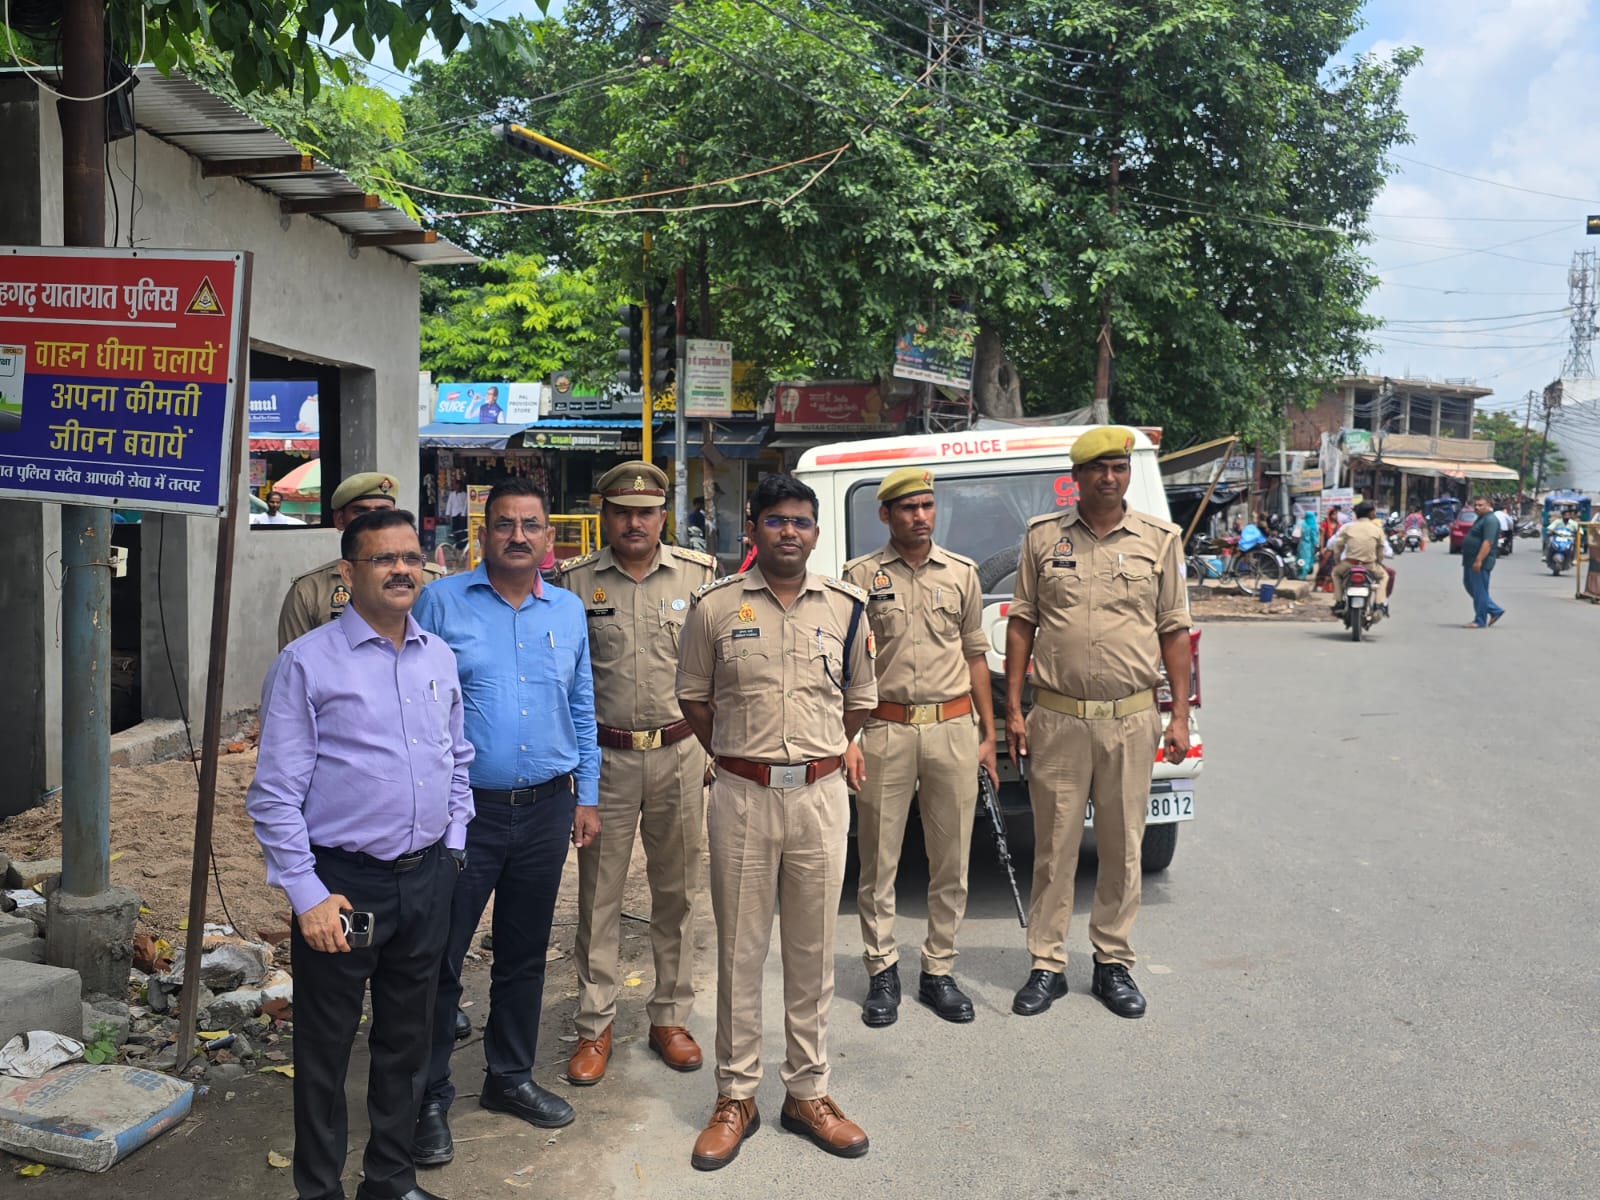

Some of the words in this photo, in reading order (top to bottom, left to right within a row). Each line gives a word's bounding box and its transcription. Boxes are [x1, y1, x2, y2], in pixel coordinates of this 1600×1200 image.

[41, 283, 118, 309] यातायात
[122, 277, 179, 319] पुलिस
[34, 340, 90, 369] वाहन
[96, 337, 147, 371] धीमा
[151, 340, 224, 375] चलायें
[50, 383, 119, 412] अपना
[123, 380, 203, 417] कीमती
[249, 394, 277, 412] mul
[438, 400, 467, 413] SURE
[49, 418, 117, 454] जीवन
[122, 425, 194, 459] बचायें
[941, 440, 1002, 456] POLICE
[16, 463, 51, 483] पुलिस
[54, 465, 82, 483] सदैव
[84, 470, 125, 486] आपकी
[128, 471, 151, 489] सेवा
[154, 473, 167, 490] में
[168, 478, 202, 492] तत्पर
[1053, 475, 1080, 497] C
[1146, 796, 1192, 817] 8012
